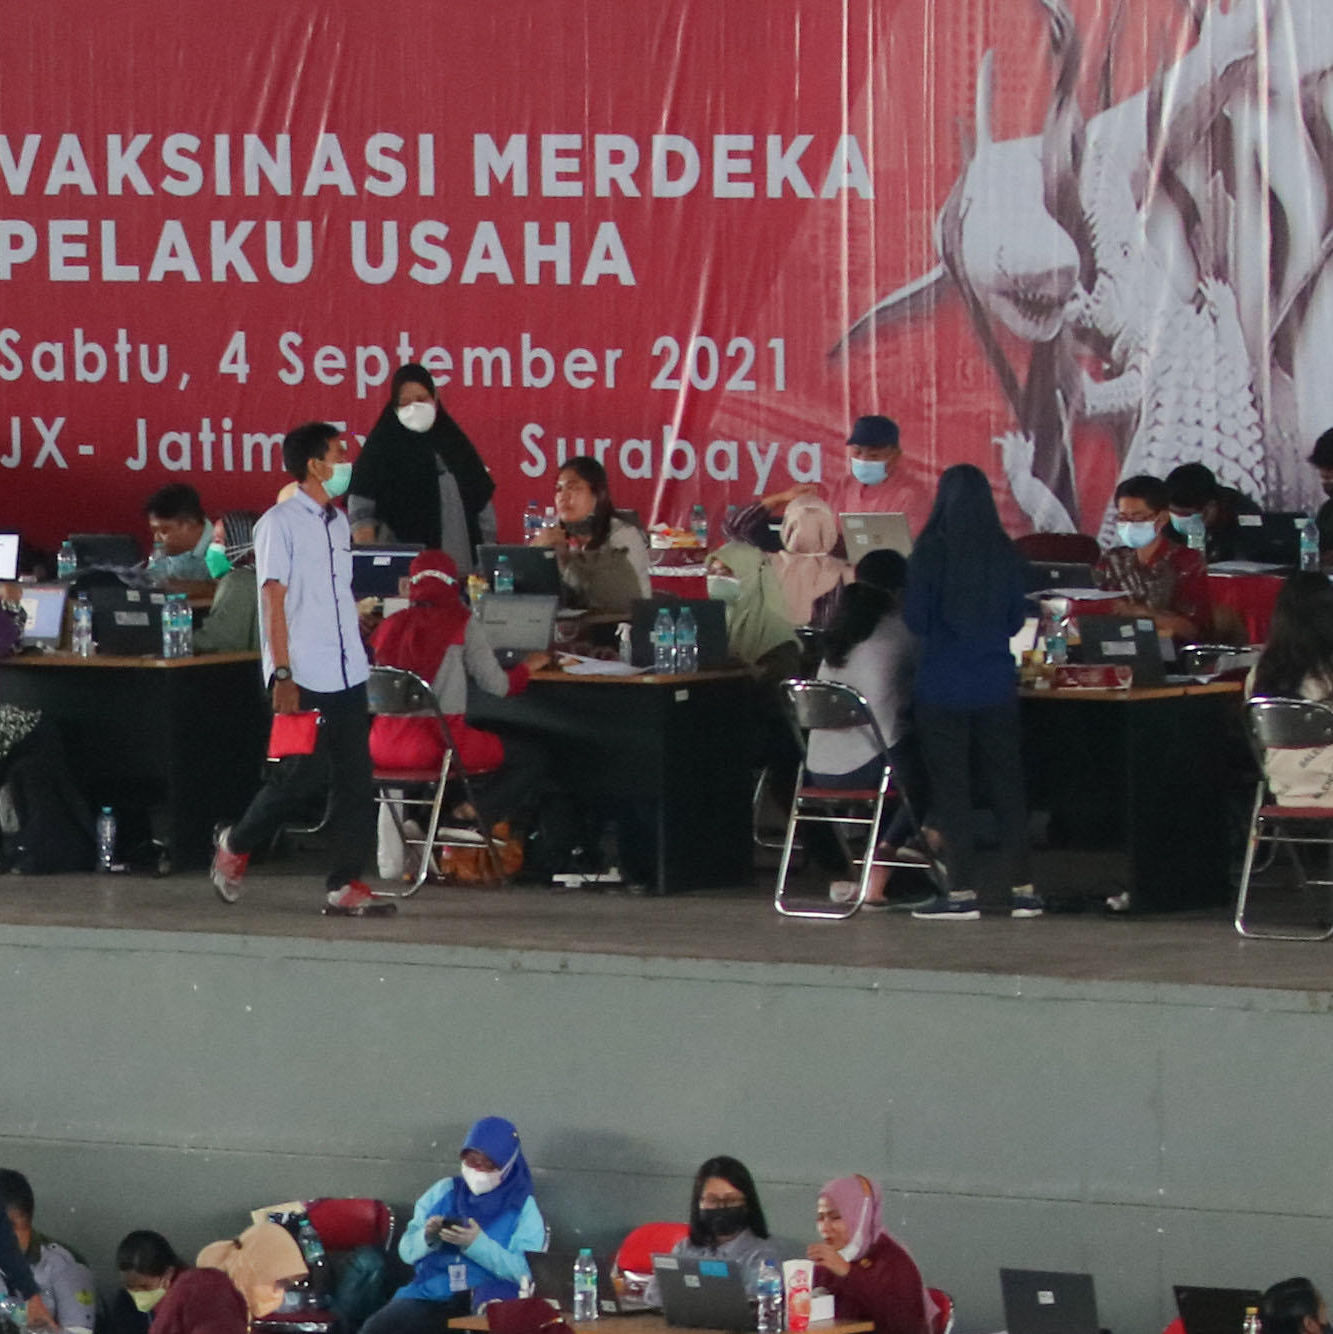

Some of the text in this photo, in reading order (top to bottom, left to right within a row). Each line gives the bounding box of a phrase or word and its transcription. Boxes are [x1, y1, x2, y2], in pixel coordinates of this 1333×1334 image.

[473, 132, 875, 200] MERDEKA
[351, 220, 636, 286] USAHA
[219, 331, 250, 384] 4
[278, 331, 623, 399] September
[650, 335, 786, 392] 2021
[0, 416, 94, 468] JX-
[125, 417, 288, 472] Jatim
[520, 422, 822, 495] Surabaya
